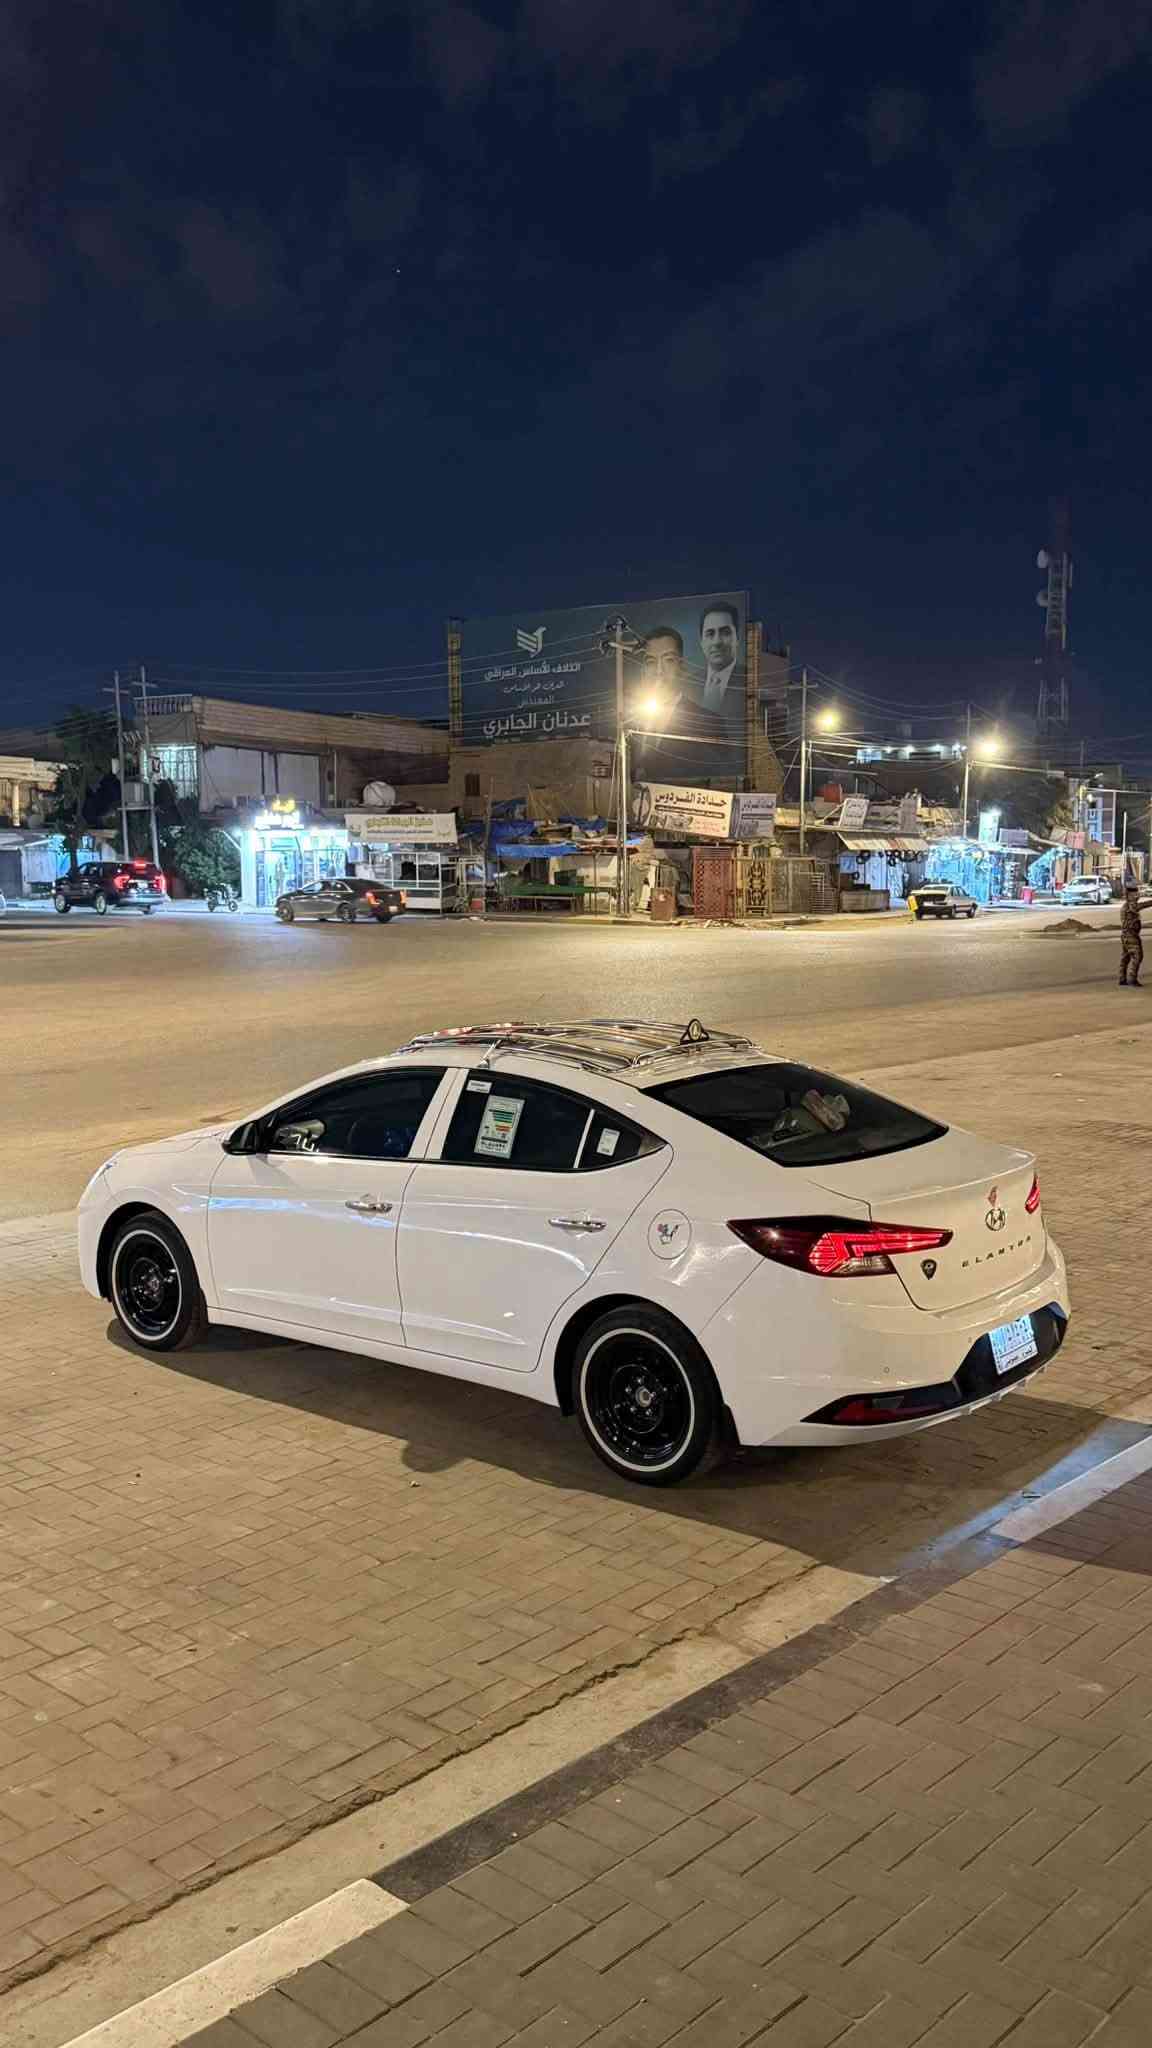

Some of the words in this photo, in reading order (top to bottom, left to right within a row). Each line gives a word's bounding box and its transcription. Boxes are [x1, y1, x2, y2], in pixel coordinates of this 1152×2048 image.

[483, 712, 537, 738] الجابري
[542, 711, 592, 731] عدنان
[655, 791, 696, 805] الفردوس
[962, 1235, 1032, 1268] ELANTRA
